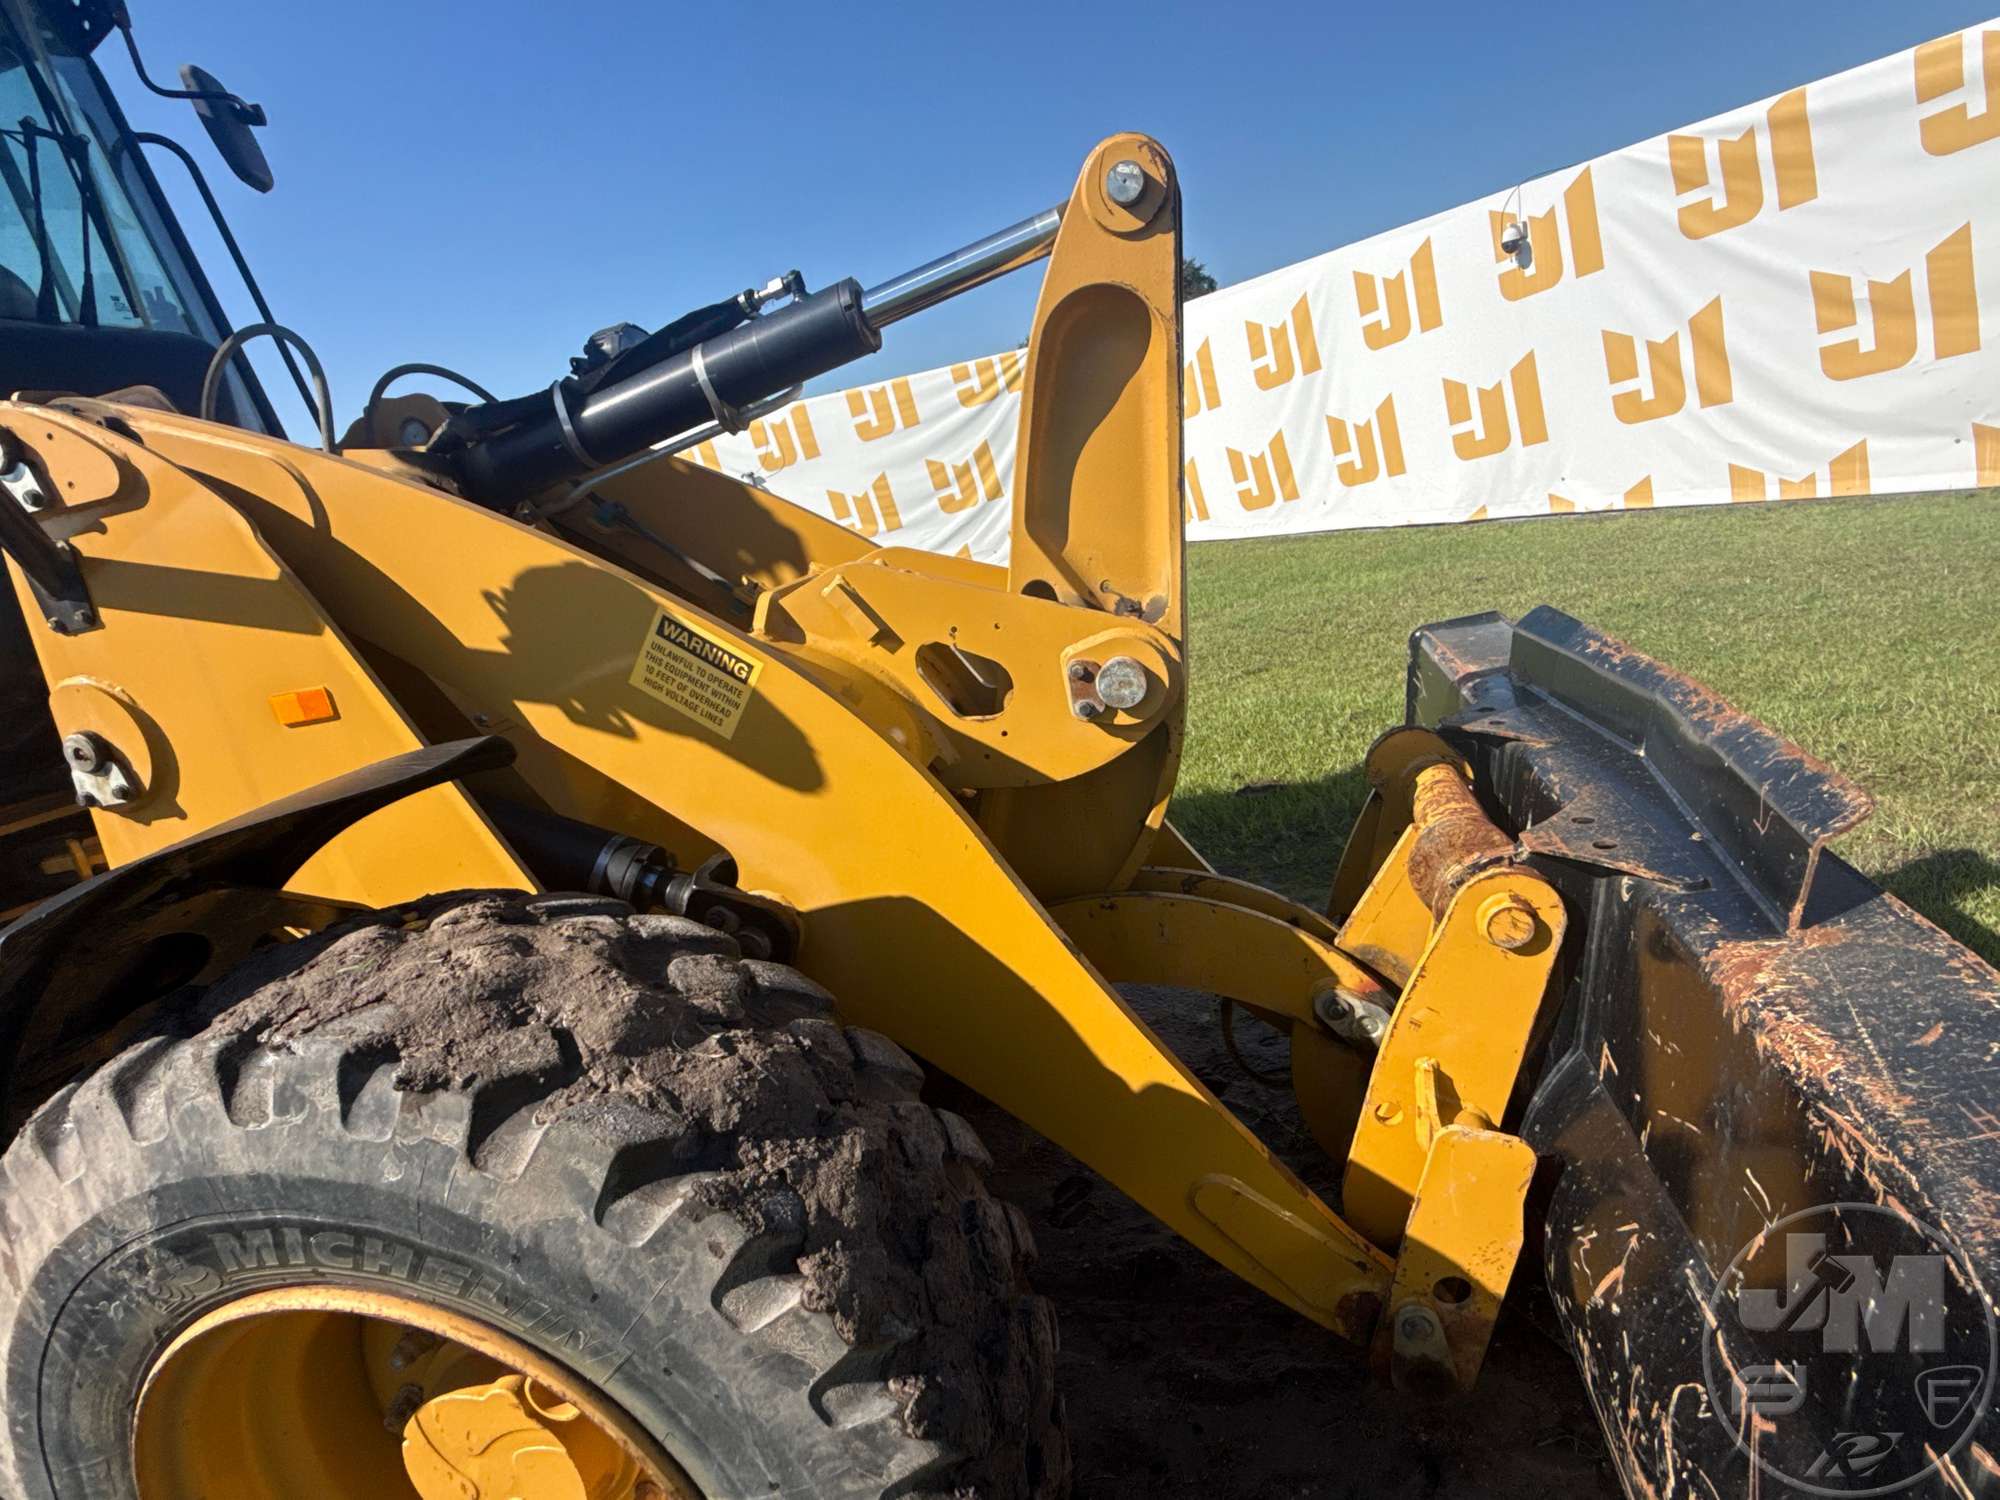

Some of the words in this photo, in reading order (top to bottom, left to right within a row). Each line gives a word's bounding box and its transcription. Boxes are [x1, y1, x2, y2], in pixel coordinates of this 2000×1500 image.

[650, 640, 694, 672] UNLAWFUL
[696, 665, 707, 678] TO
[707, 673, 744, 699] OPERATE
[662, 619, 750, 680] WARNING
[643, 676, 665, 693] HIGH
[665, 687, 701, 713] VOLTAGE
[700, 708, 724, 727] LINES
[645, 650, 665, 667] THIS
[663, 661, 711, 693] EQUIPMENT
[711, 687, 741, 711] WITHIN
[646, 664, 655, 675] 10
[655, 670, 676, 687] FEET
[676, 681, 689, 693] OF
[689, 688, 732, 718] OVERHEAD
